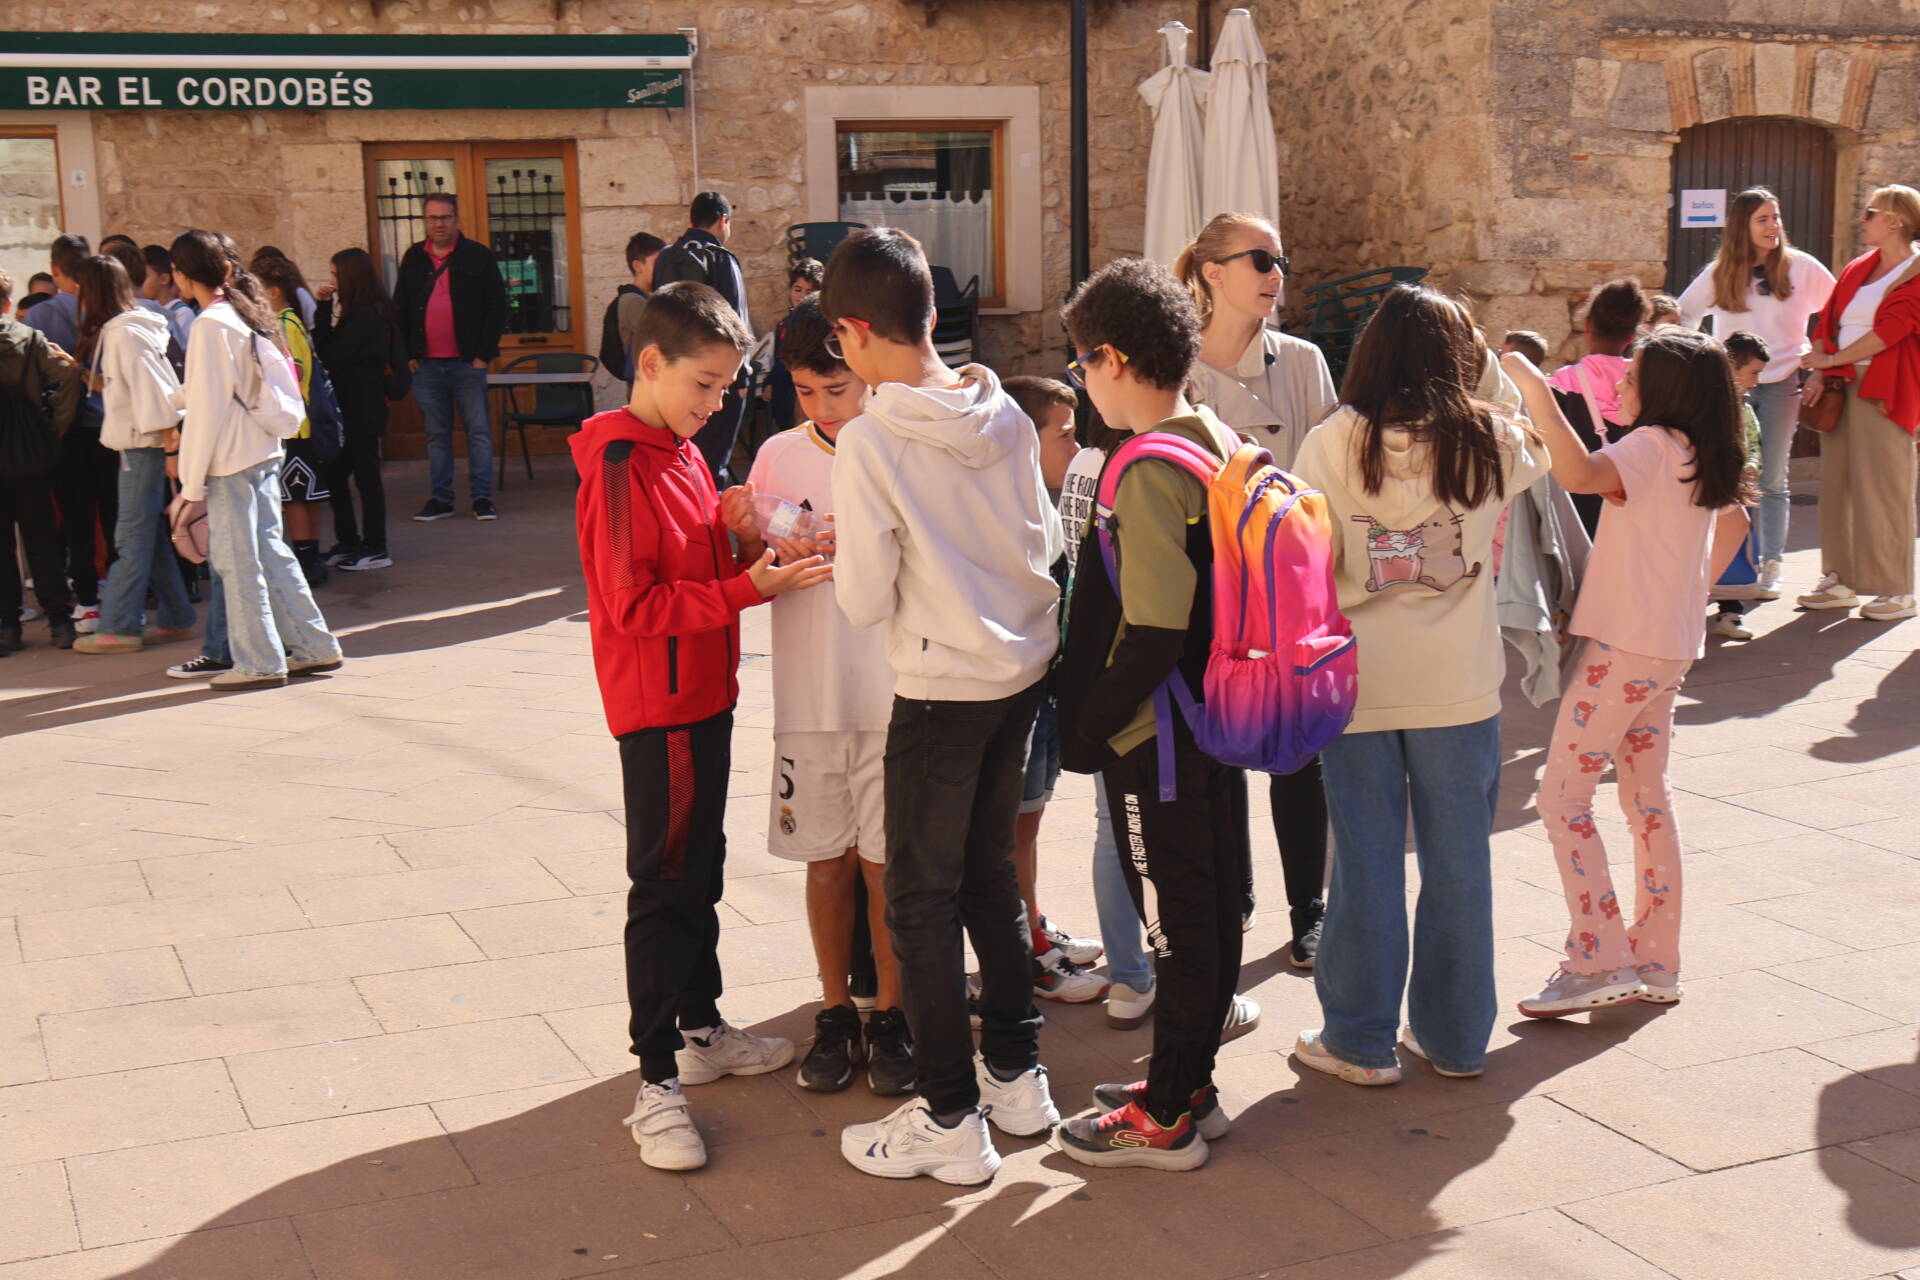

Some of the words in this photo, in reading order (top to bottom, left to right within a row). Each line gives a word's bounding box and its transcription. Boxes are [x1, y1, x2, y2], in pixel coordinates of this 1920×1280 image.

[26, 76, 103, 106] BAR
[118, 77, 162, 106] EL
[177, 71, 373, 107] CORDOBÉS
[779, 755, 794, 800] 5
[1123, 793, 1139, 805] ON
[1125, 804, 1140, 813] IS
[1126, 811, 1143, 835] MOVE
[1128, 833, 1147, 861] FASTER
